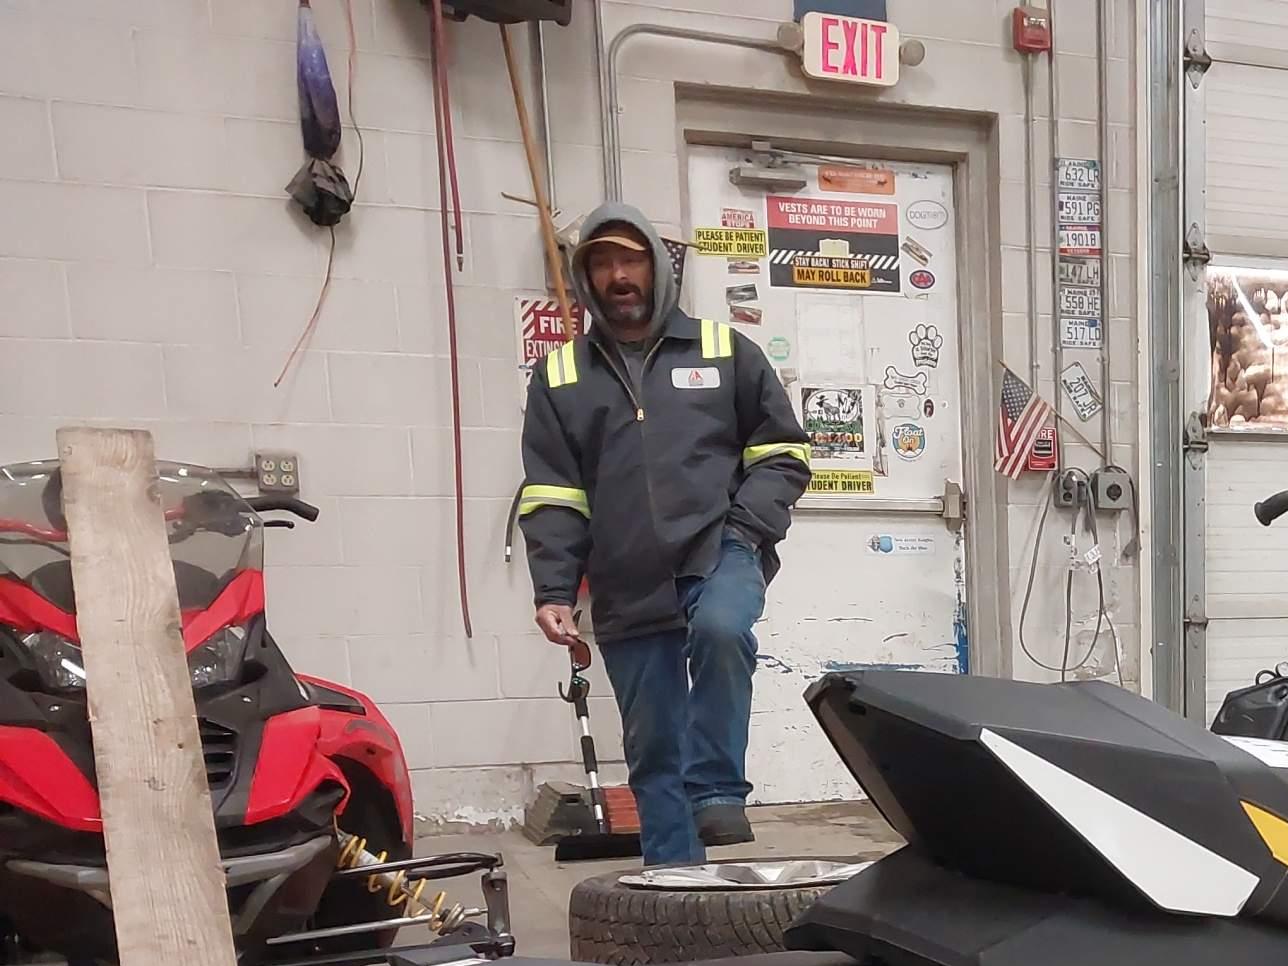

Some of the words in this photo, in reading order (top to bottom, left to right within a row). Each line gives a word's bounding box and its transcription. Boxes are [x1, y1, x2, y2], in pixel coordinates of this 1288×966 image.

[821, 17, 887, 79] EXIT
[1065, 167, 1084, 182] 632
[1087, 168, 1100, 183] LR
[778, 202, 808, 214] VESTS
[810, 204, 829, 215] ARE
[830, 205, 842, 216] TO
[844, 206, 857, 217] BE
[858, 207, 886, 218] WORN
[1065, 202, 1083, 216] 591
[1086, 202, 1100, 216] PG
[722, 213, 754, 221] AMERICA
[788, 214, 826, 226] BEYOND
[828, 216, 849, 227] THIS
[850, 217, 878, 228] POINT
[697, 230, 723, 241] PLEASE
[724, 231, 734, 241] BE
[735, 232, 763, 242] PATIENT
[1066, 233, 1096, 247] 19018
[699, 241, 733, 252] STUDENT
[736, 242, 764, 254] DRIVER
[794, 256, 810, 267] STAY
[831, 258, 850, 269] STICK
[850, 260, 869, 270] SHIFT
[796, 268, 816, 281] MAY
[818, 269, 842, 283] ROLL
[843, 270, 867, 284] BACK
[1087, 264, 1099, 280] LH
[1065, 296, 1084, 310] 558
[1087, 297, 1100, 311] HE
[539, 315, 578, 335] FIRE
[1066, 327, 1086, 340] 517
[1069, 376, 1089, 399] 207
[1083, 401, 1097, 415] JR
[807, 480, 839, 491] TUDENT
[841, 480, 873, 491] DRIVER
